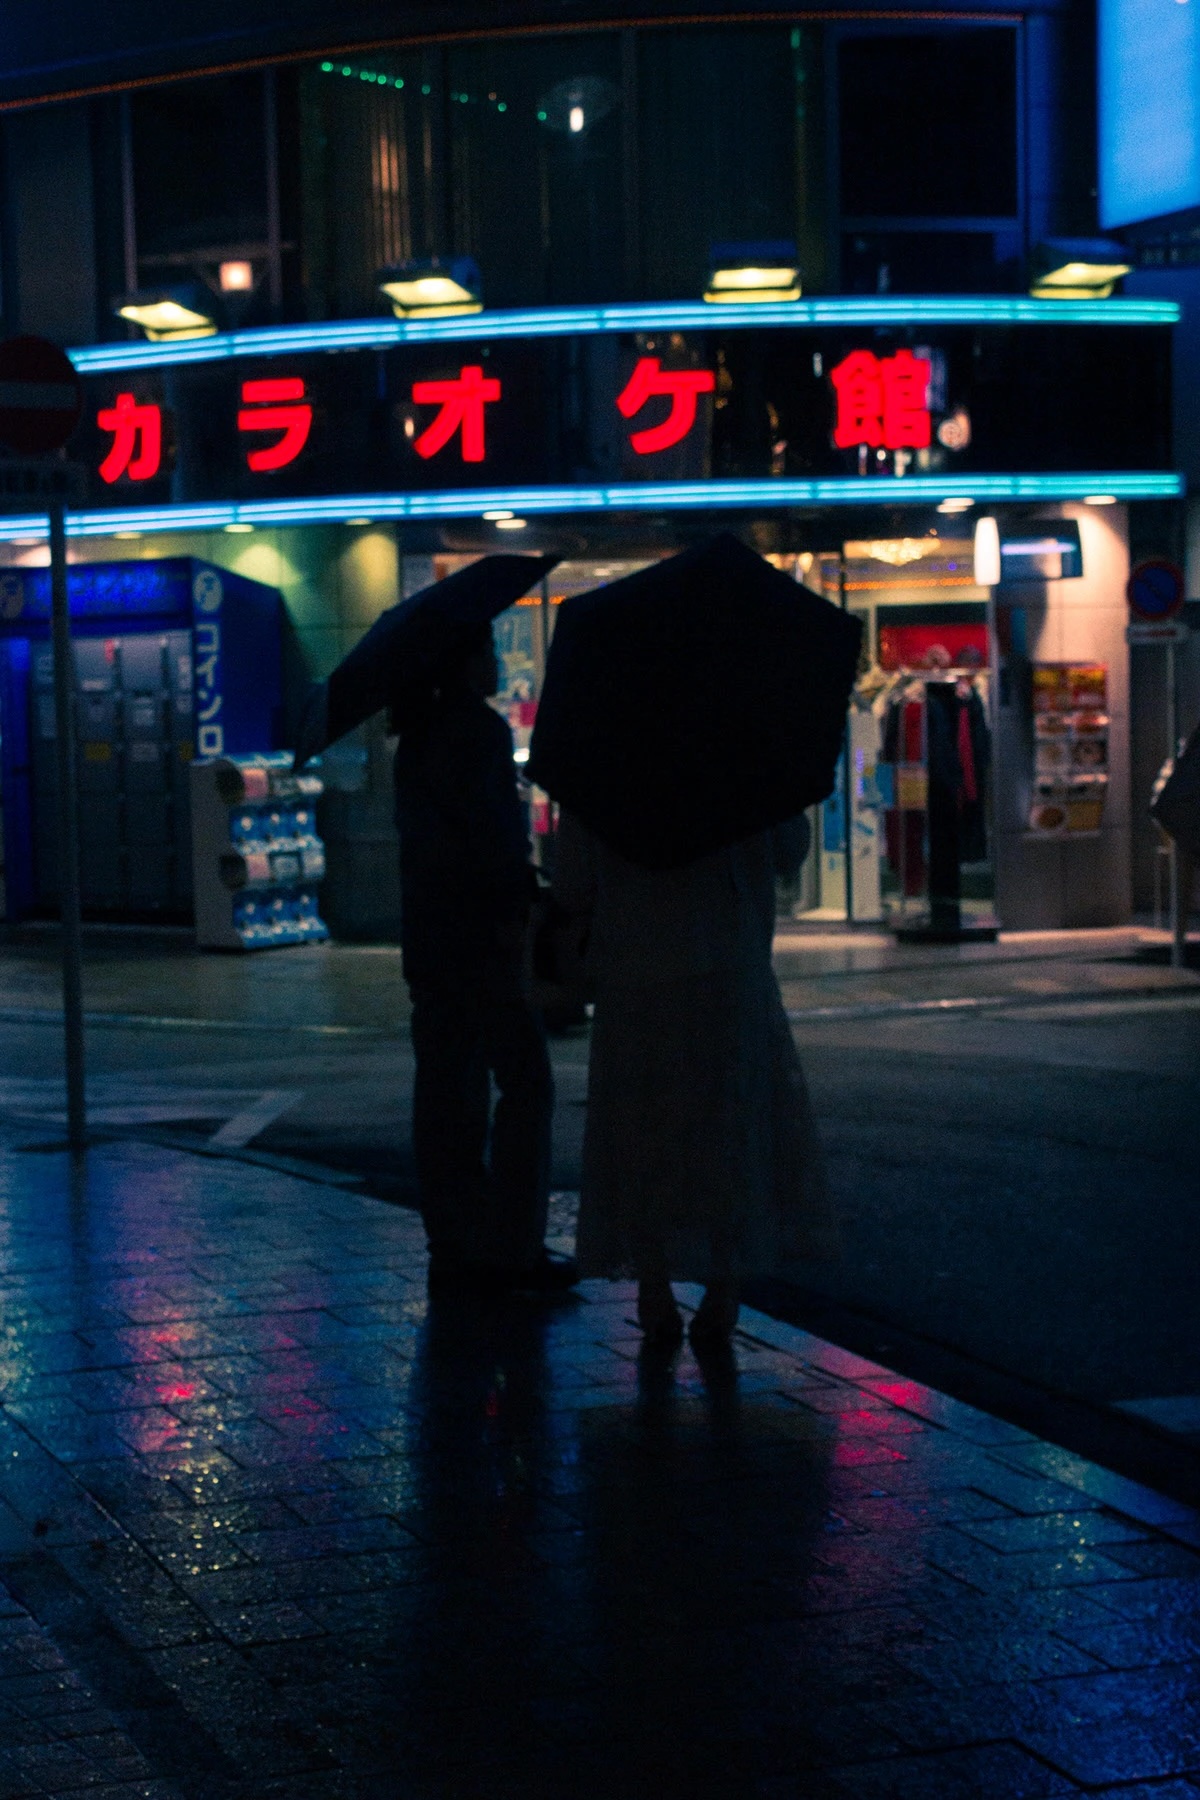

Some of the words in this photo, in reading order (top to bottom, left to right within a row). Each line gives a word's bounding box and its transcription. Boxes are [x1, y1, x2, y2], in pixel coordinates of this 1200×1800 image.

[97, 350, 933, 483] カラオケ館
